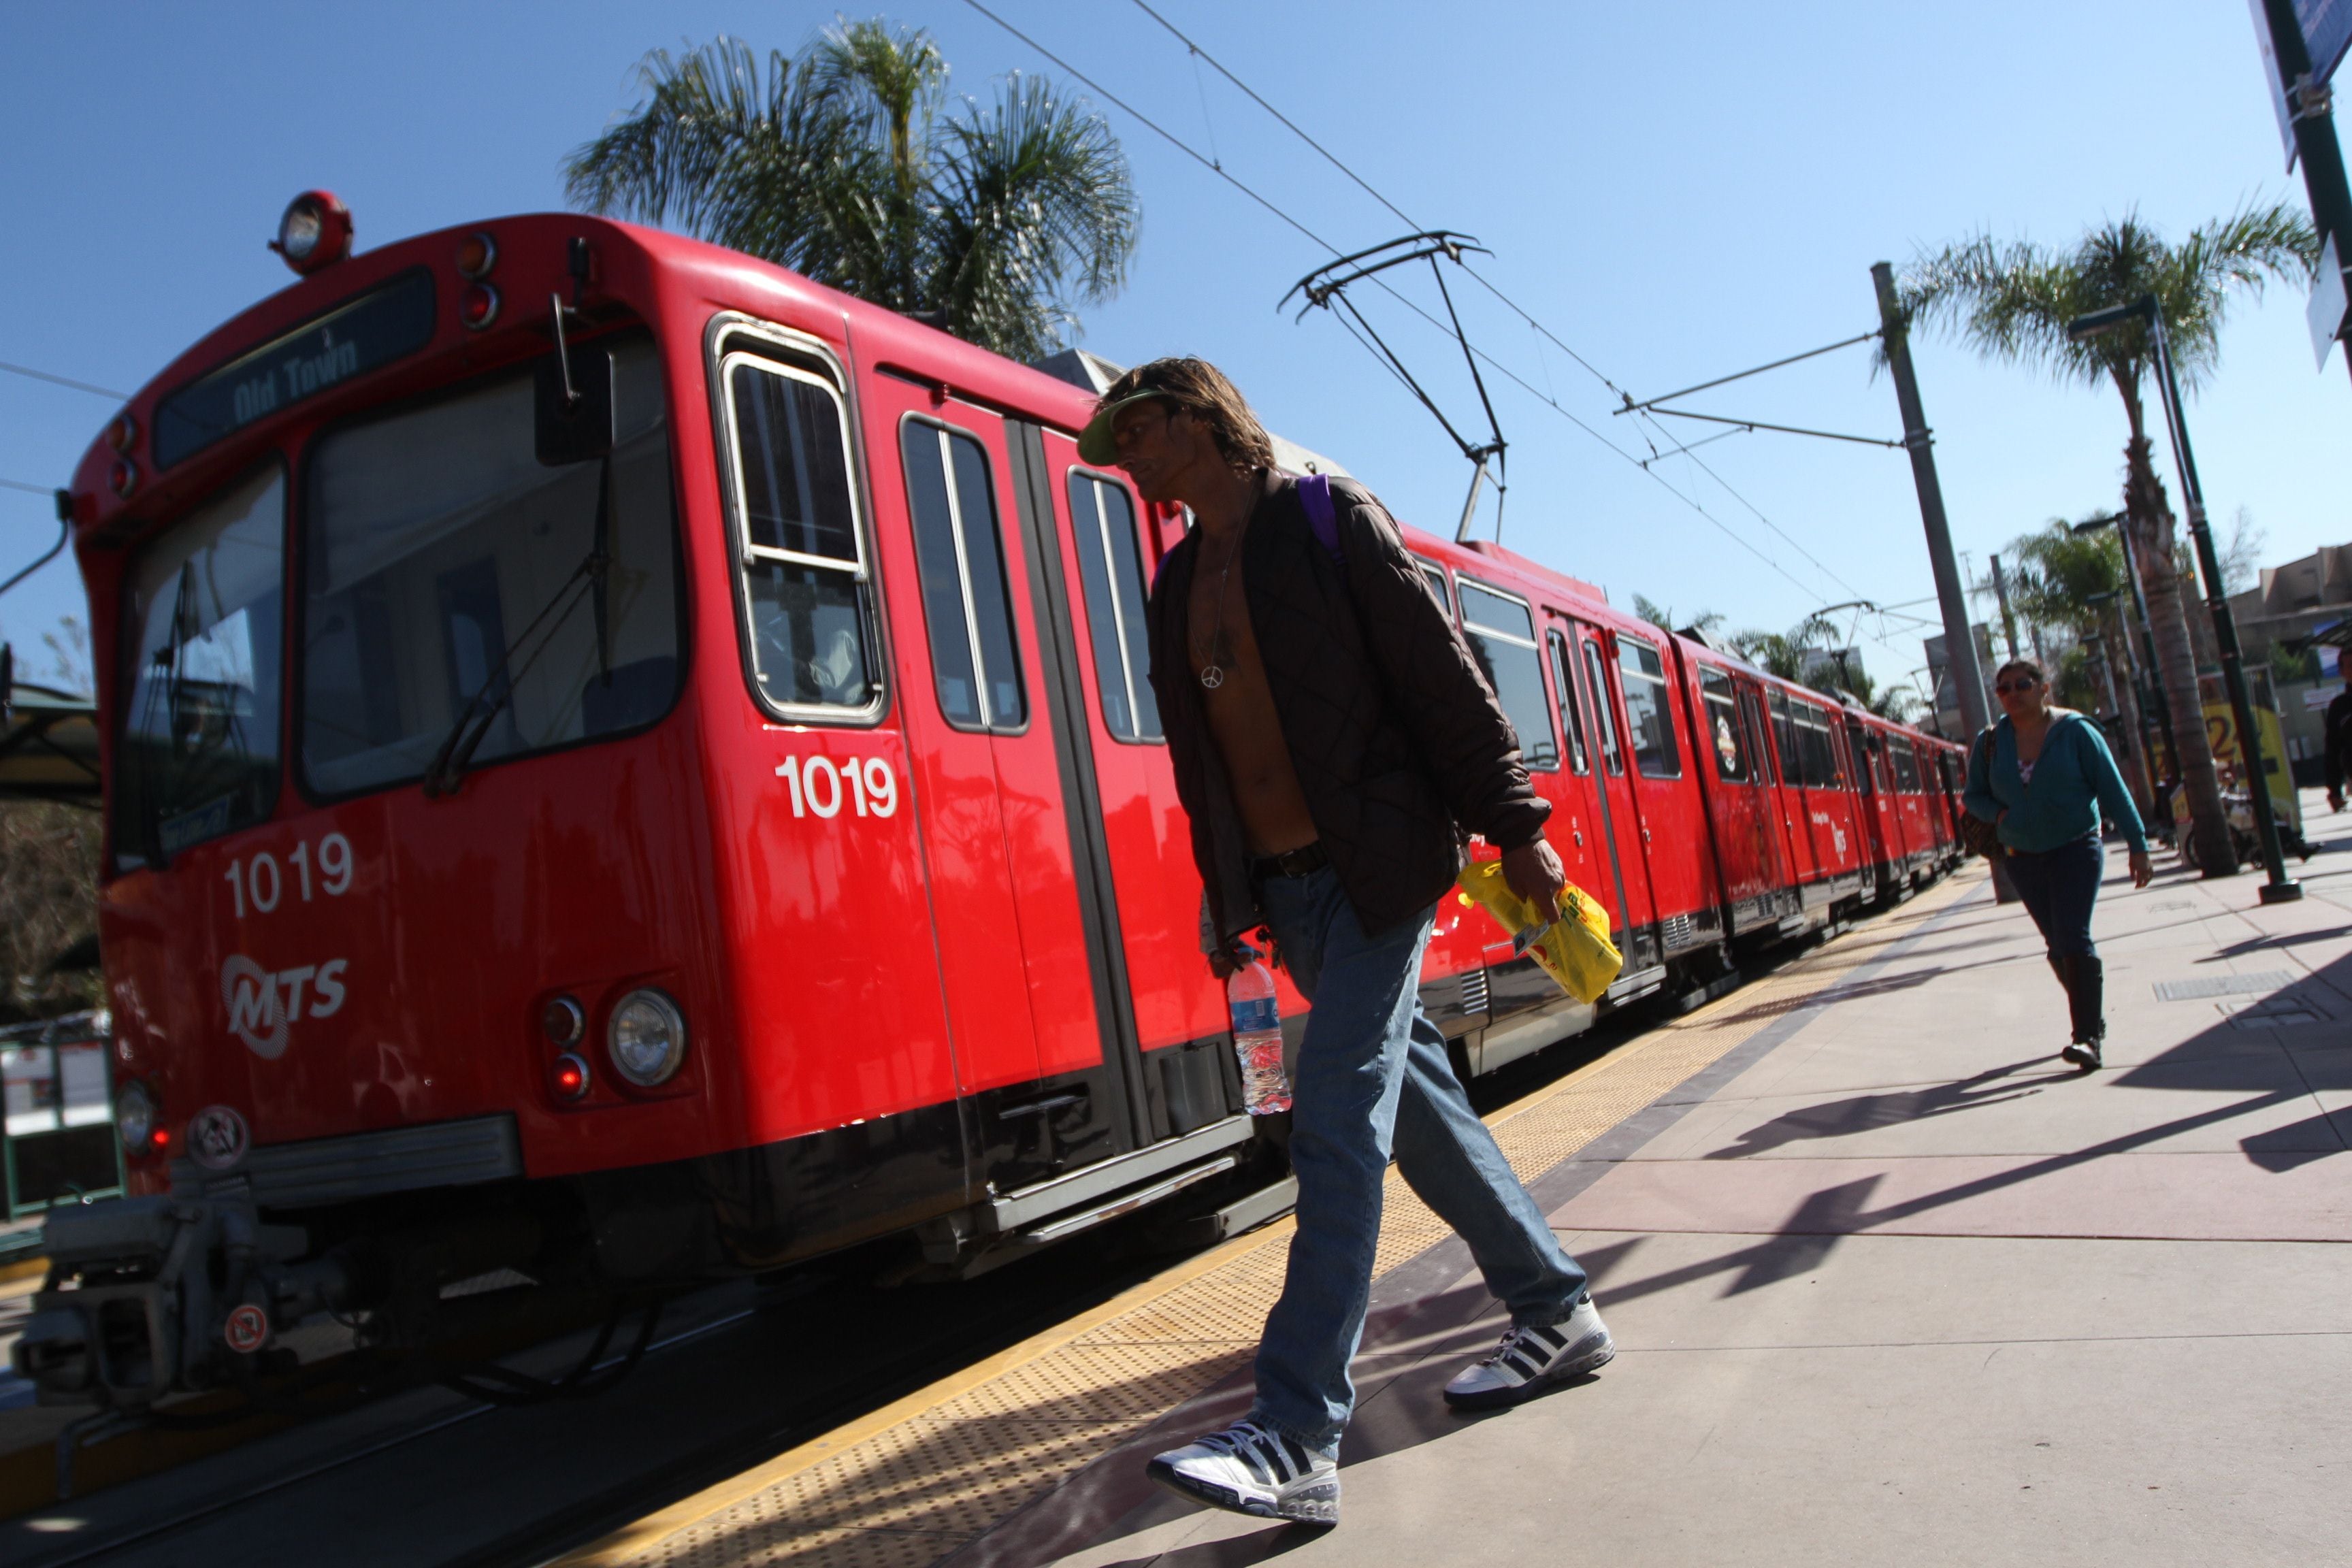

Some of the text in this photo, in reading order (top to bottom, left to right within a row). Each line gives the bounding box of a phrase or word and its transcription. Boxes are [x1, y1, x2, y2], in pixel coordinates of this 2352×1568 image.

[233, 341, 357, 423] Old Town
[774, 755, 898, 818] 1019
[224, 832, 353, 918] 1019
[227, 958, 348, 1034] MTS
